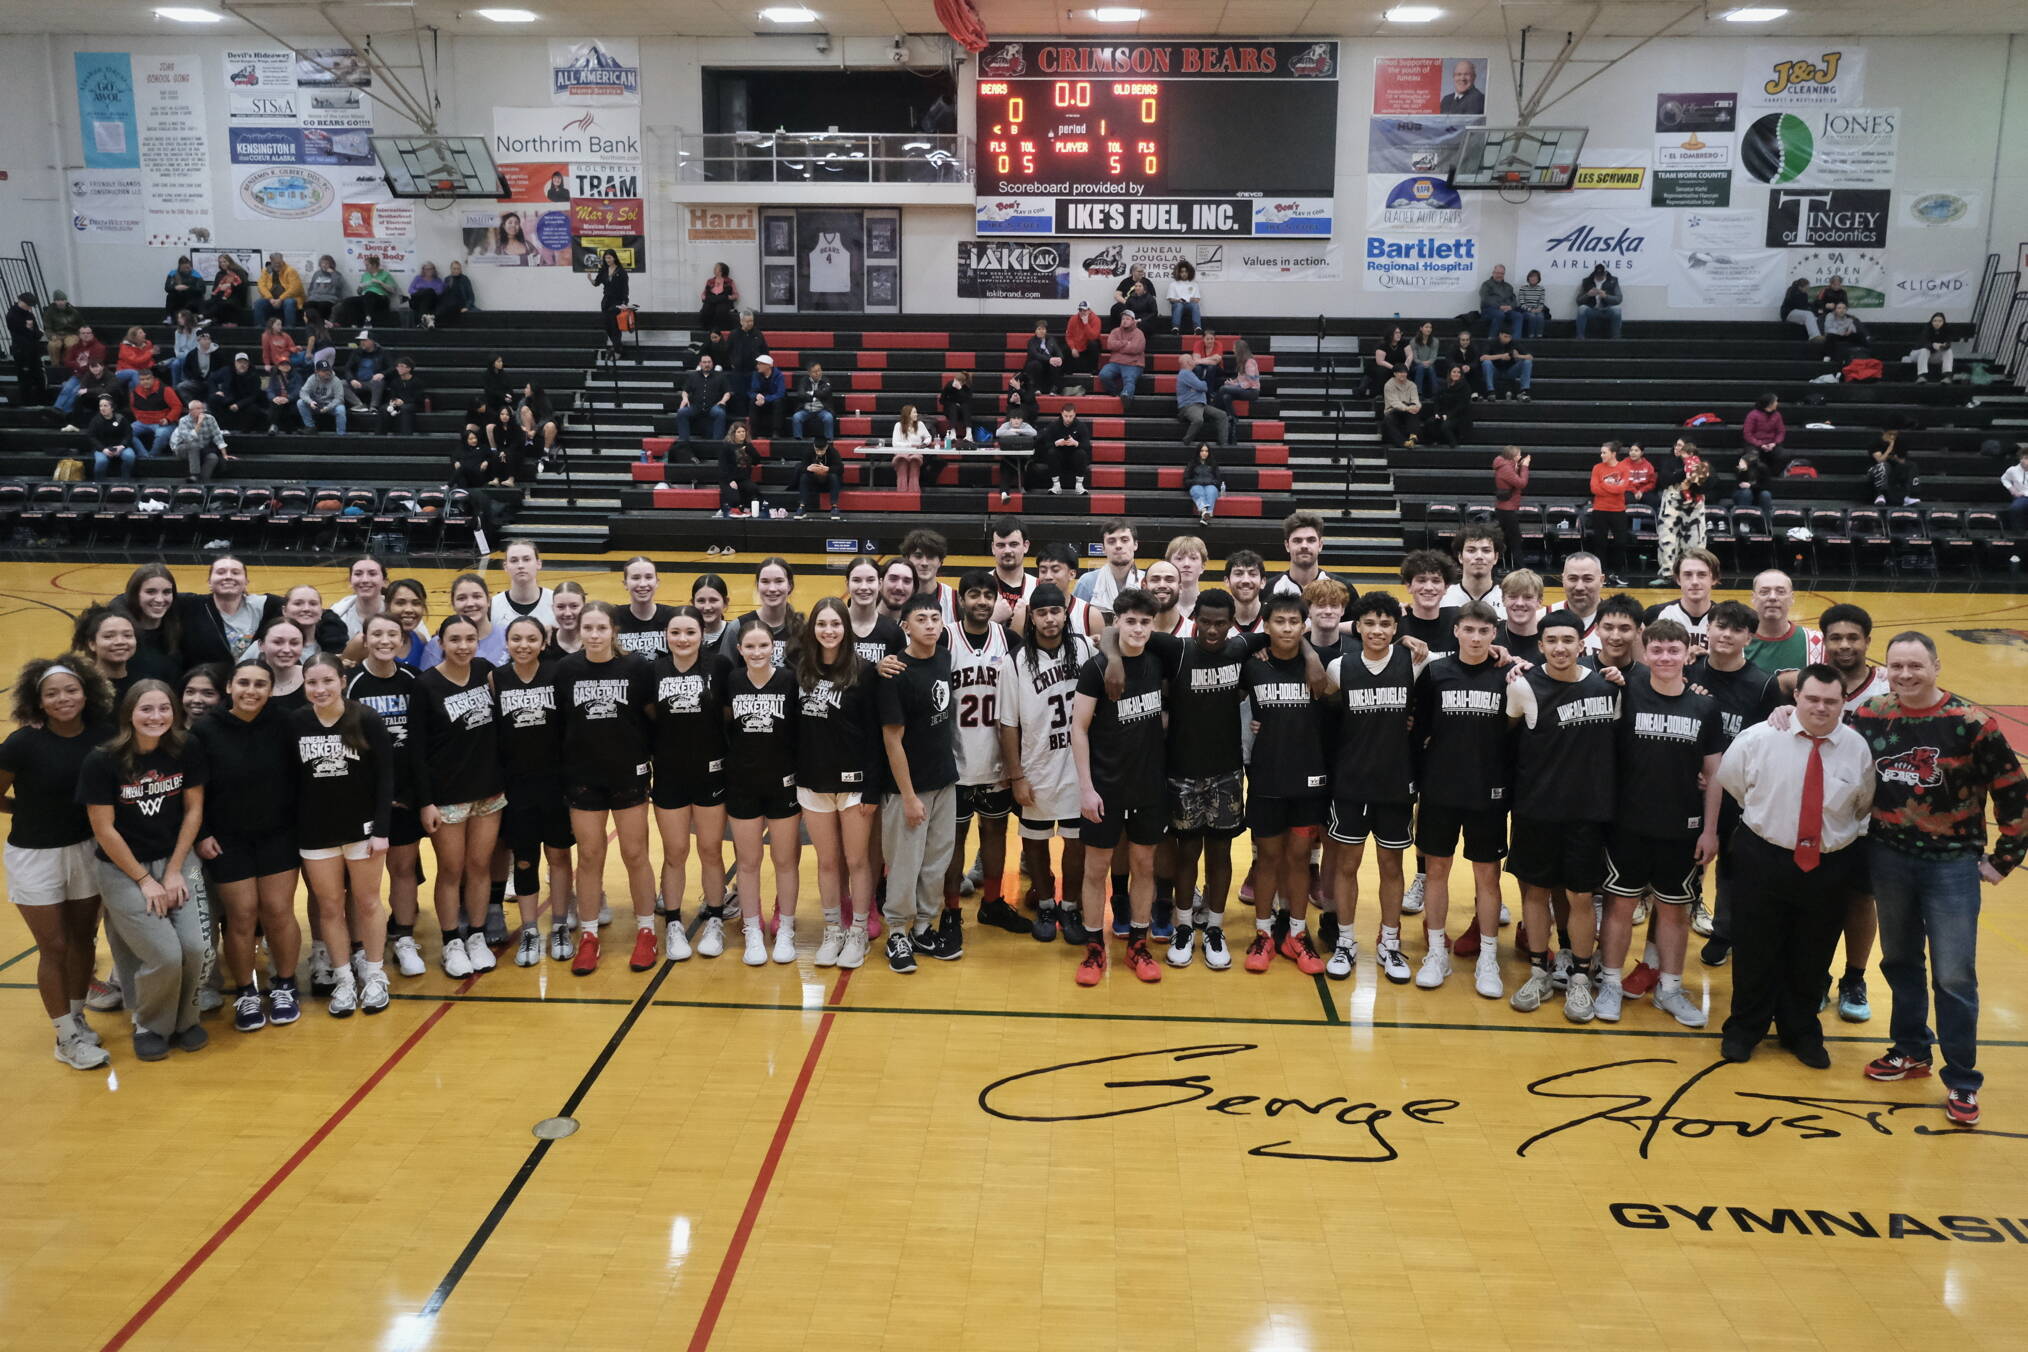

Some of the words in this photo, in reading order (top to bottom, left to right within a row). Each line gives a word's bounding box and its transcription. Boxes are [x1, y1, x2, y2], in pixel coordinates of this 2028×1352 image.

[254, 52, 290, 60] Hideaway
[1038, 47, 1171, 73] CRIMSON
[1181, 47, 1277, 73] BEARS
[557, 71, 577, 86] ALL
[580, 70, 636, 86] AMERICAN
[1764, 52, 1842, 95] J&J
[981, 84, 1008, 95] BEARS
[1055, 82, 1090, 107] 0.0
[1114, 84, 1131, 95] OLD
[1131, 84, 1158, 95] BEARS
[1788, 85, 1836, 95] CLEANING
[1009, 98, 1023, 122] 0
[1142, 98, 1156, 123] 0
[1058, 123, 1086, 135] period
[1820, 113, 1895, 138] JONES
[237, 143, 289, 154] KENSINGTON
[497, 136, 582, 153] Northrim
[589, 136, 639, 153] Bank
[990, 142, 1007, 152] FLS
[1020, 142, 1036, 152] TOL
[1055, 142, 1089, 153] PLAYER
[1108, 142, 1123, 152] TOL
[1138, 142, 1155, 152] FLS
[998, 156, 1009, 173] 0
[1023, 156, 1034, 173] 5
[1110, 156, 1121, 174] 5
[1146, 156, 1157, 174] 0
[576, 175, 637, 198] TRAM
[1578, 172, 1597, 183] LES
[1599, 172, 1639, 184] SCHWAB
[999, 181, 1069, 194] Scoreboard
[1073, 181, 1126, 196] provided
[1129, 181, 1145, 196] by
[576, 206, 602, 220] Mar
[617, 207, 638, 221] Sol
[1068, 203, 1125, 230] IKE'S
[1130, 203, 1187, 233] FUEL,
[1193, 203, 1239, 231] INC.
[1384, 210, 1415, 224] GLACIER
[1417, 210, 1437, 224] AUTO
[1439, 210, 1463, 224] PARTS
[1778, 191, 1880, 246] TINGEY
[1367, 237, 1475, 259] Bartlett
[1546, 225, 1645, 256] Alaska
[382, 253, 406, 261] Body
[826, 254, 832, 264] 4
[1035, 254, 1054, 265] AK
[1243, 257, 1277, 266] Values
[1281, 256, 1290, 266] in
[1293, 256, 1330, 266] action.
[1367, 262, 1419, 273] Regional
[1422, 262, 1473, 273] Hospital
[1816, 267, 1861, 275] ASPEN
[1379, 273, 1429, 288] QUALITY
[951, 665, 1000, 691] BEAR
[500, 685, 555, 697] JUNEAU-DOUGLAS
[573, 685, 629, 708] BASKETBALL
[1349, 687, 1408, 707] JUNEAU-DOUGLAS
[500, 692, 557, 717] BASKETBALL
[1441, 690, 1501, 711] JUNEAU-DOUGLAS
[1557, 695, 1613, 721] JUNEAU-DOUGLA
[733, 700, 785, 720] BASKETBALL
[960, 694, 996, 728] 20
[1635, 712, 1701, 738] JUNEAU-DOUGLAS
[1049, 731, 1072, 751] BEA
[1885, 768, 1920, 783] BEARS
[979, 1044, 1461, 1163] George
